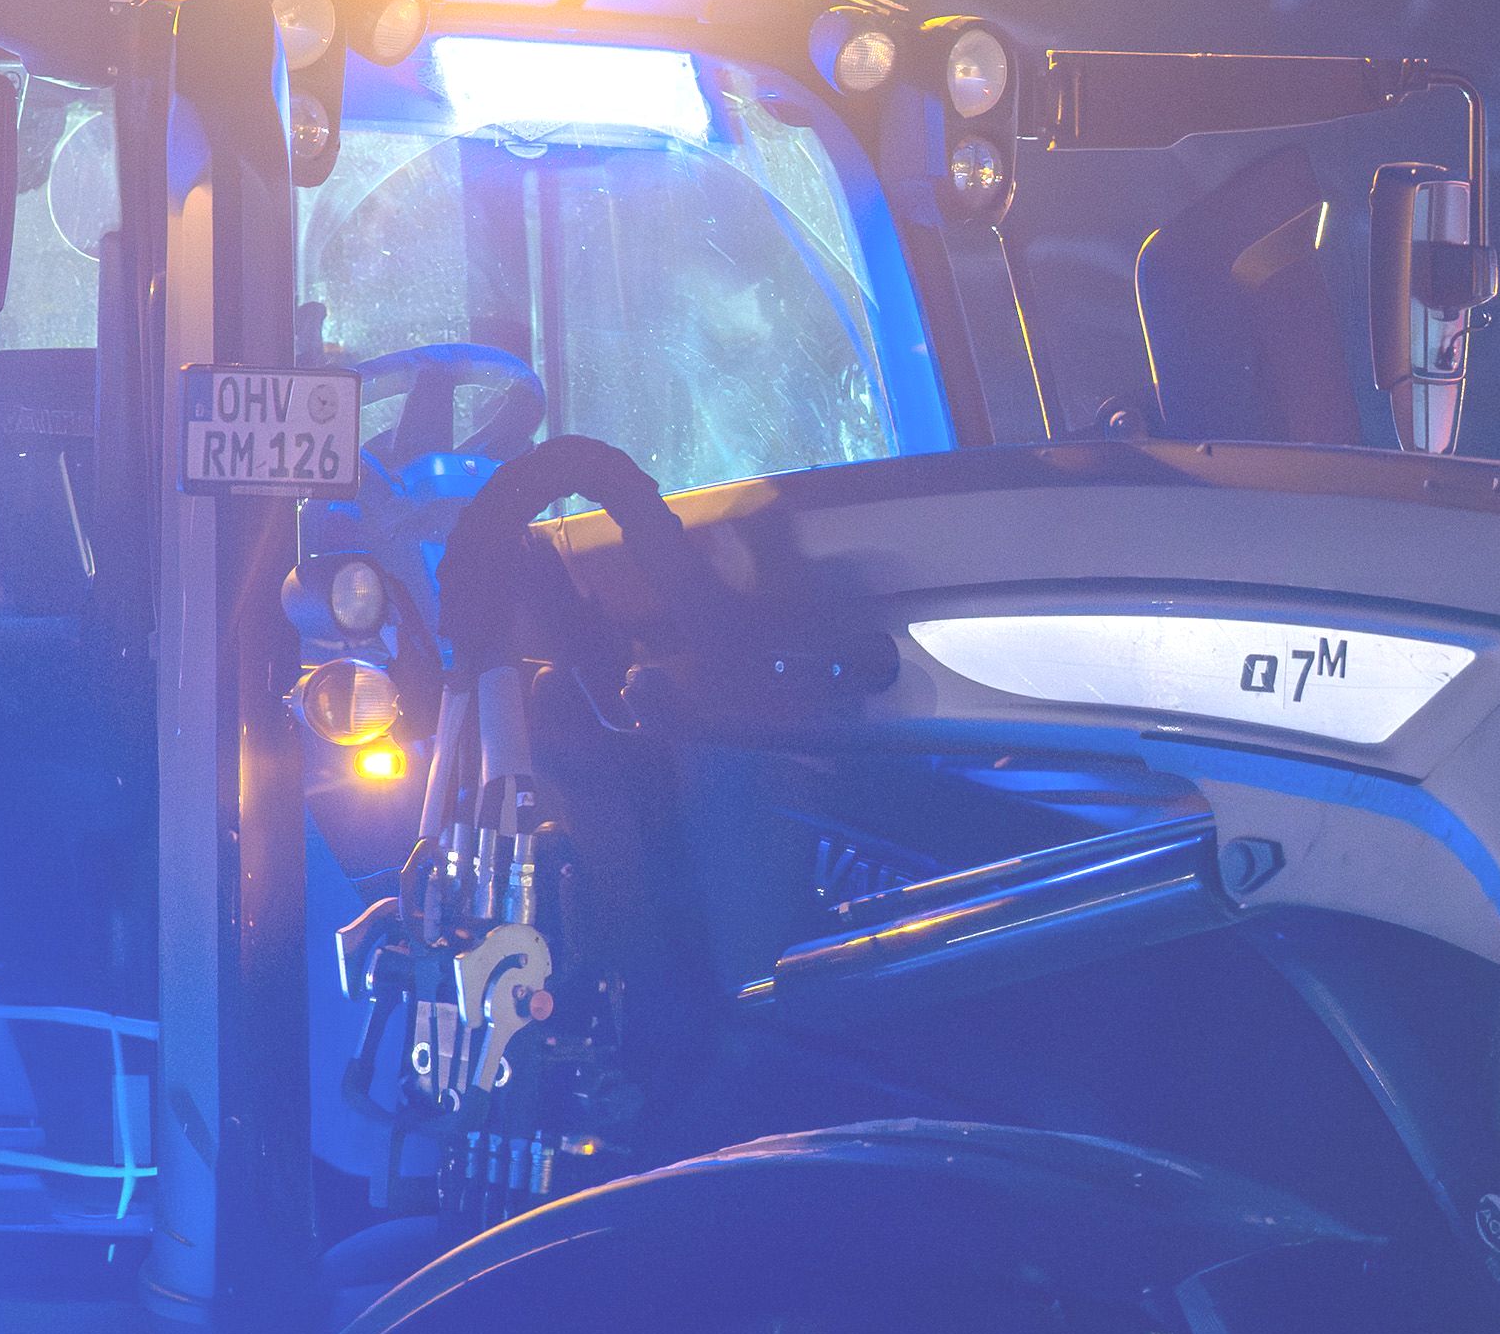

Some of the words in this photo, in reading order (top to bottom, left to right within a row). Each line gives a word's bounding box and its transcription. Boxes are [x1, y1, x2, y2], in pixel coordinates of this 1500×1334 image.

[217, 376, 295, 423] OHV
[202, 430, 254, 478] RM
[268, 432, 340, 480] 126
